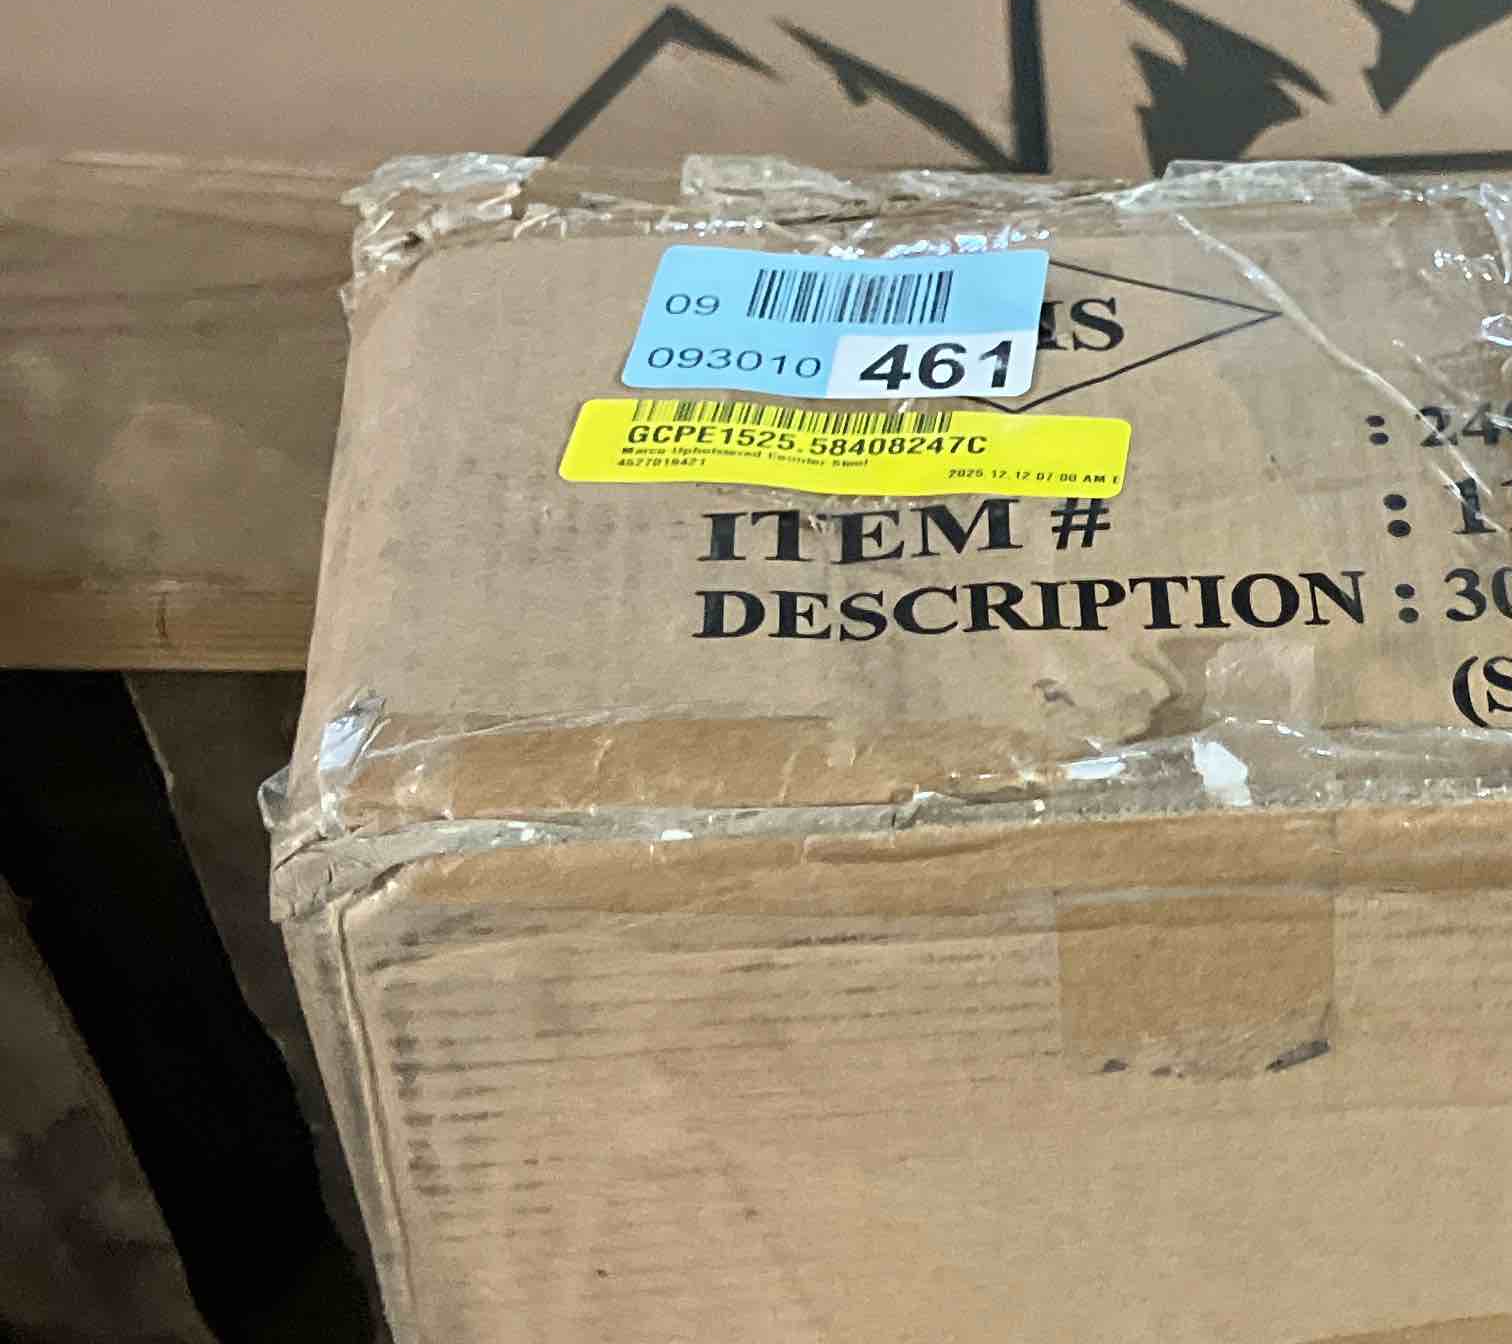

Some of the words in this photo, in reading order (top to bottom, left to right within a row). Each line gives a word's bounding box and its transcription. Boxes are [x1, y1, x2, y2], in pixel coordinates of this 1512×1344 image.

[665, 293, 720, 316] 09
[647, 347, 822, 379] 093010
[860, 340, 1013, 390] 461
[627, 424, 988, 456] GCPE1525.58408247C
[697, 497, 1023, 565] ITEM
[1050, 497, 1112, 551] #
[692, 569, 1367, 642] DESCRIPTION
